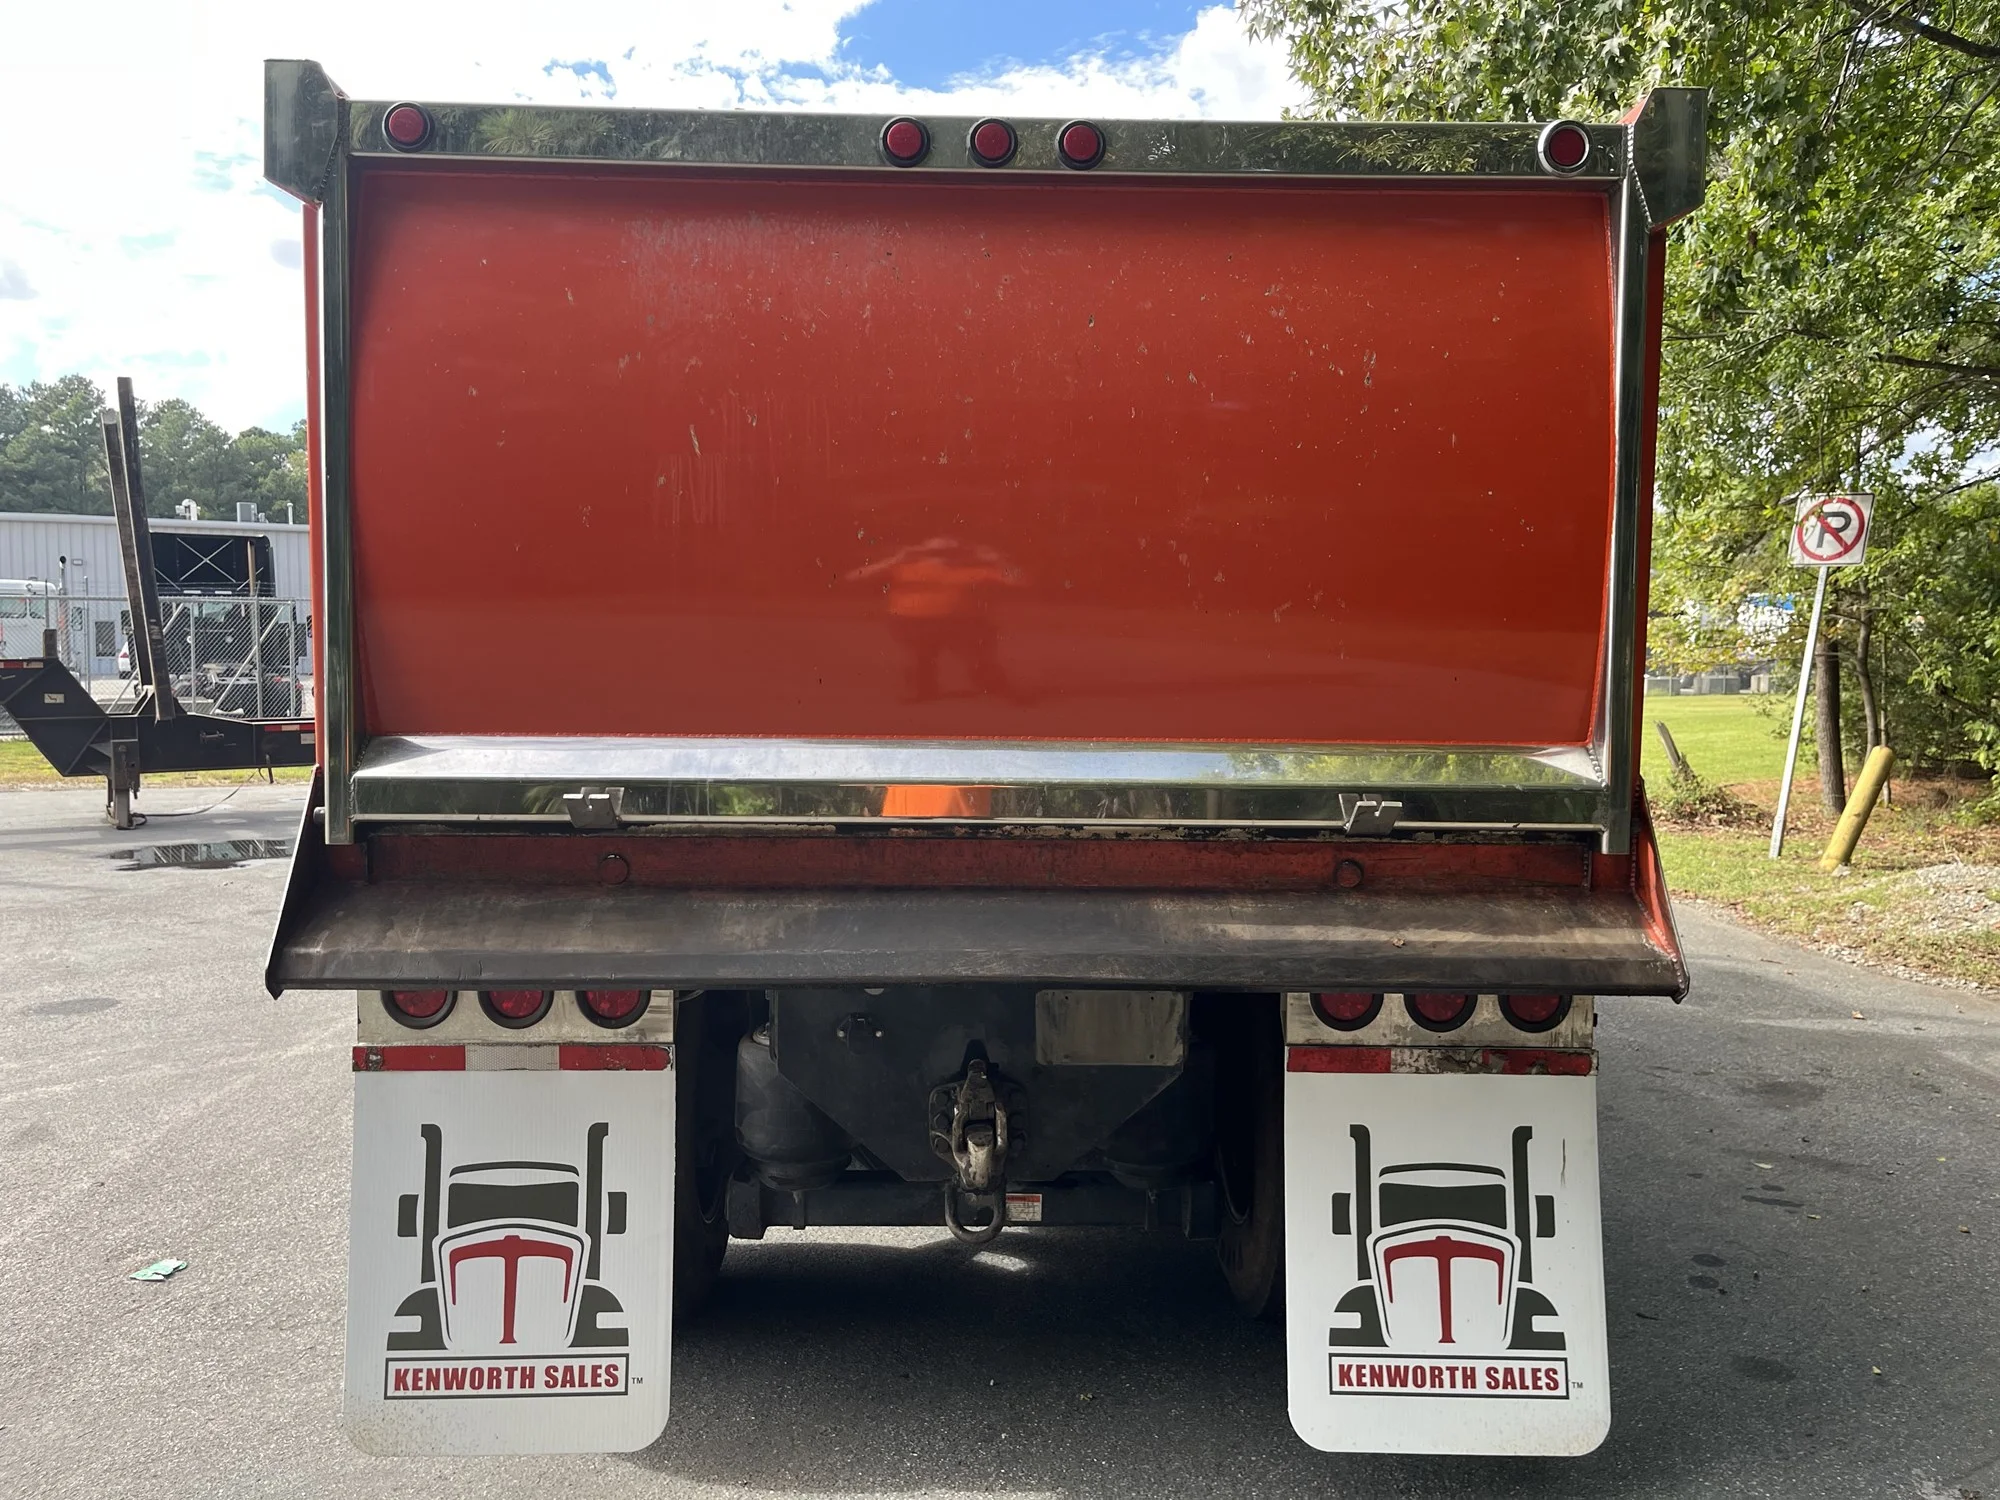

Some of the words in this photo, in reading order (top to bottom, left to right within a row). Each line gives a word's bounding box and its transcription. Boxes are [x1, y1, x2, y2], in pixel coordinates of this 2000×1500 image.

[393, 1365, 536, 1391] KENWORTH
[543, 1363, 620, 1389] SALES
[1337, 1363, 1477, 1389] KENWORTH
[1485, 1366, 1560, 1392] SALES
